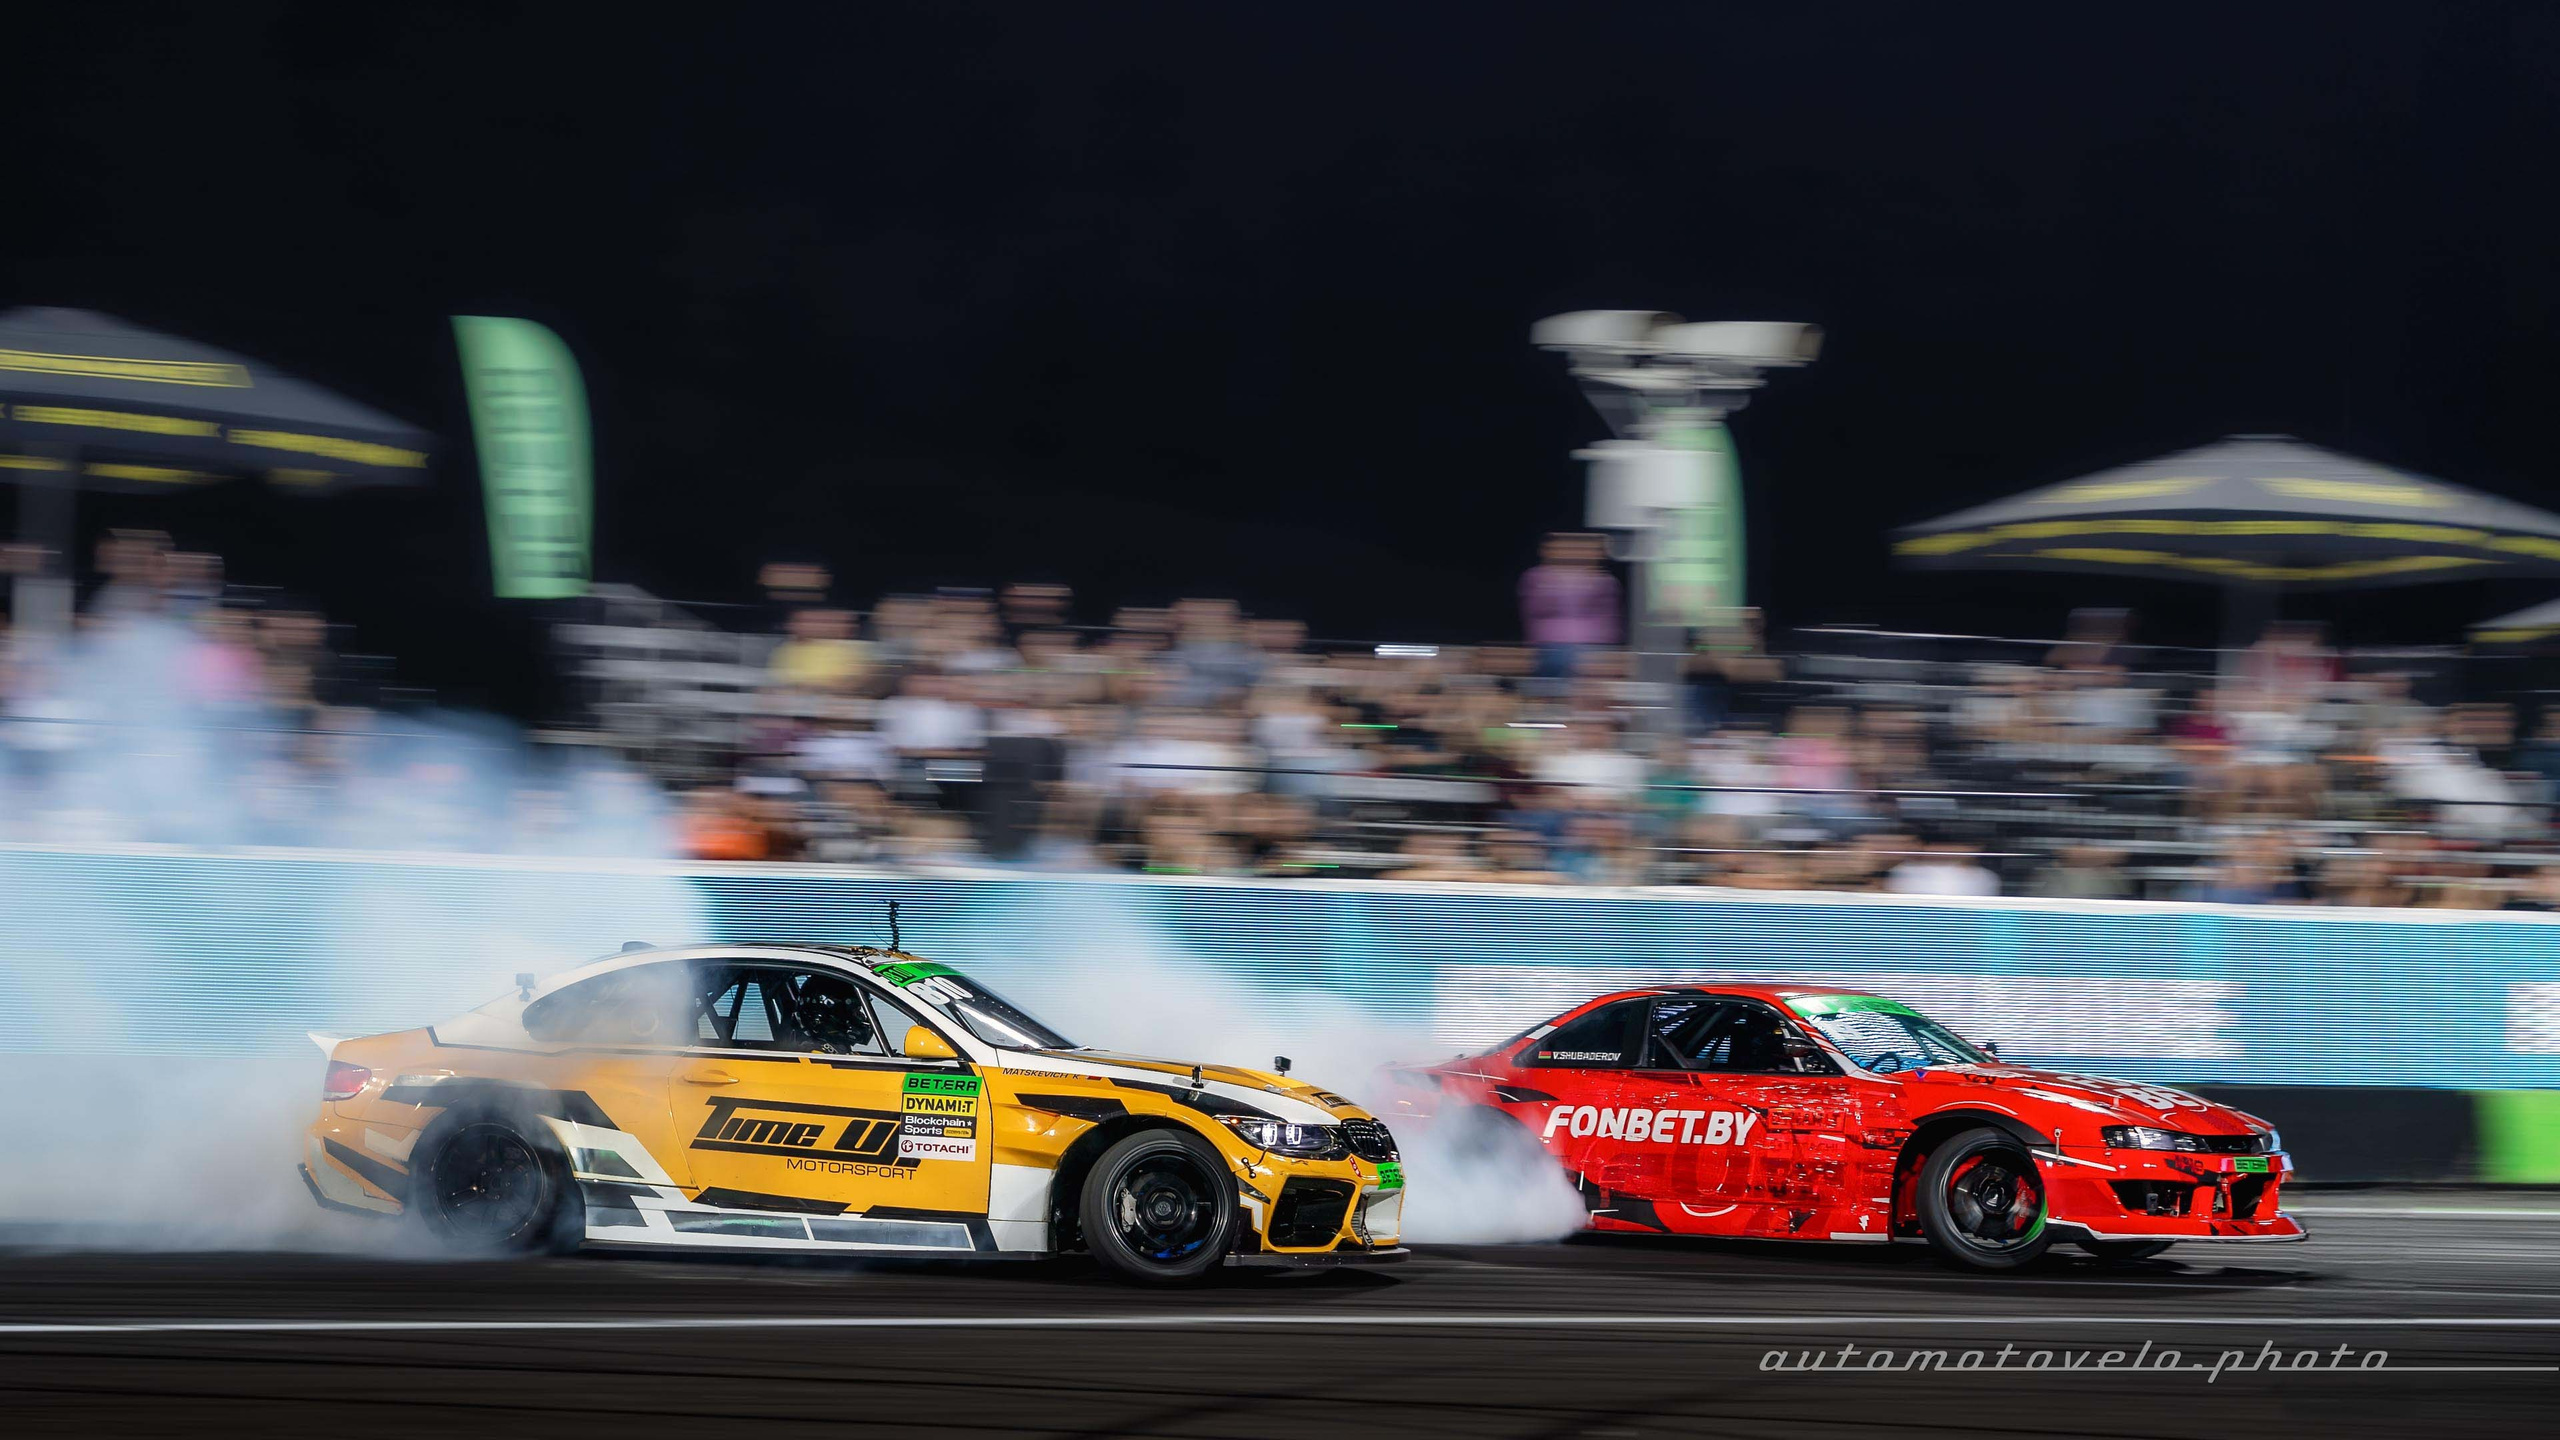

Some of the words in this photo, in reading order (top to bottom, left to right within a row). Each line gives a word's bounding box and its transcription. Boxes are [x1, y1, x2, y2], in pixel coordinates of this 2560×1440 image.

[907, 976, 973, 1005] 810
[1002, 1067, 1069, 1079] MATSKEVICH
[905, 1115, 966, 1127] Blockchain
[1542, 1105, 1757, 1146] FONBET.BY
[904, 1124, 943, 1135] Sports
[915, 1143, 969, 1154] TOTACHI
[786, 1158, 917, 1180] MOTORSPORT
